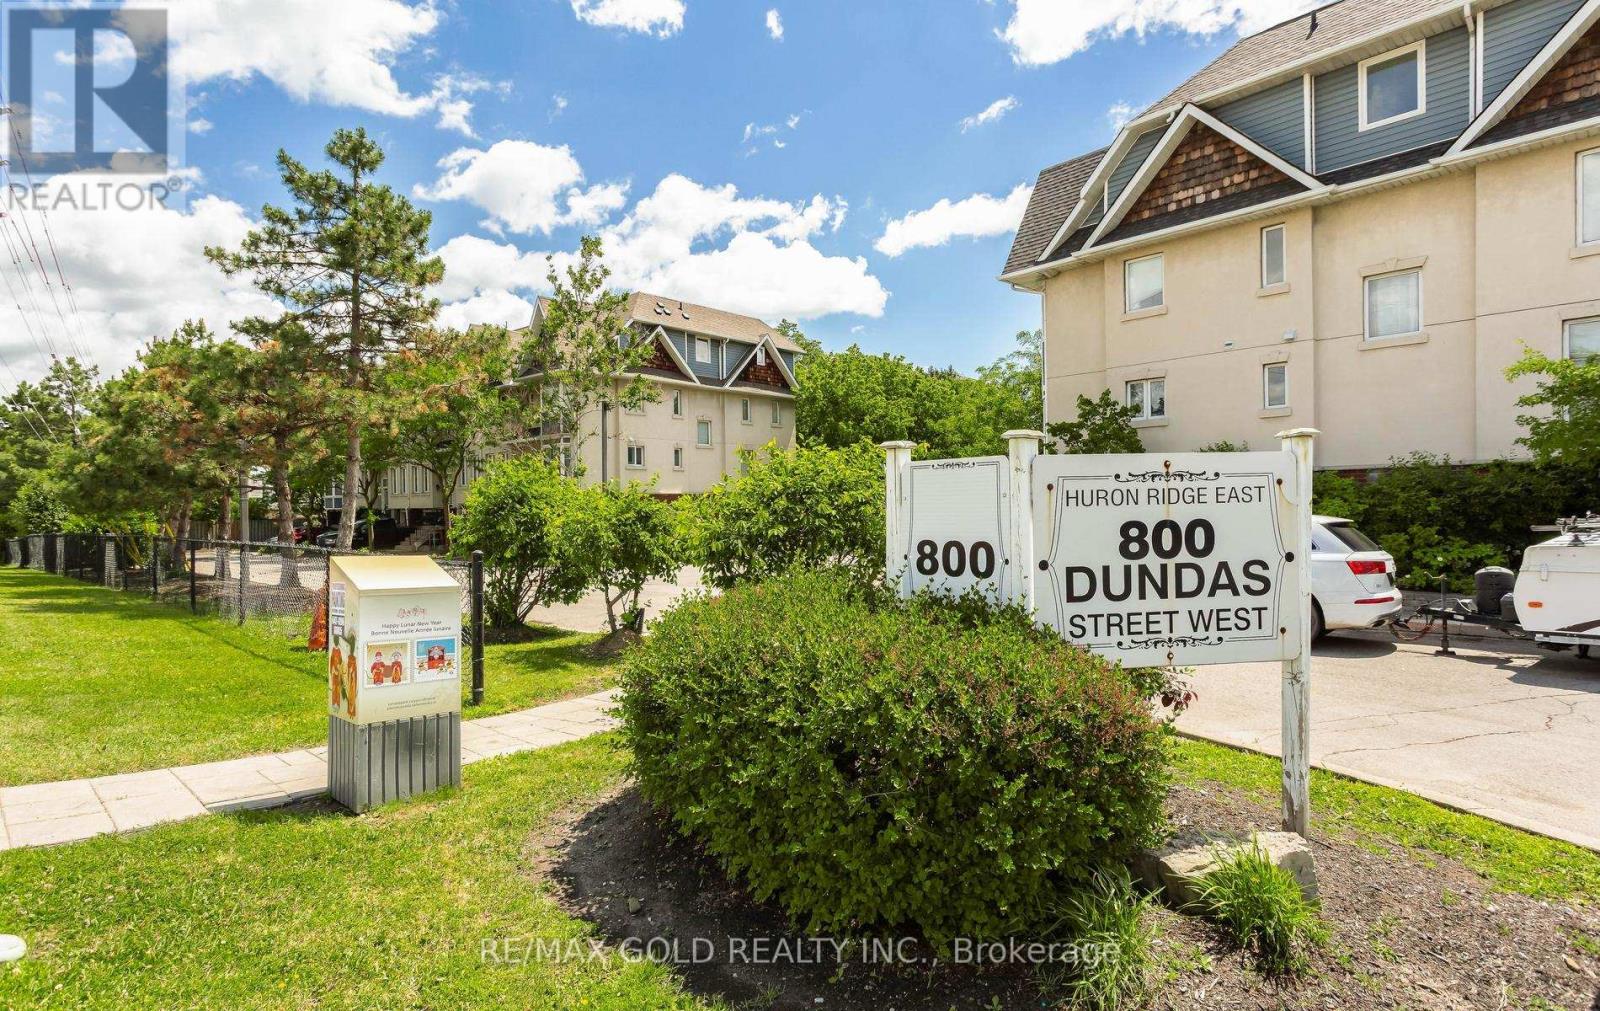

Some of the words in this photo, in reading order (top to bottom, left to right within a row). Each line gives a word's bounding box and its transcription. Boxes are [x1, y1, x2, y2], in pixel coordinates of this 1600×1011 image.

[1065, 487, 1140, 507] HURON
[1147, 485, 1208, 505] RIDGE
[1215, 484, 1266, 504] EAST
[915, 539, 996, 579] 800
[1118, 518, 1215, 561] 800
[1065, 559, 1272, 603] DUNDAS
[1068, 609, 1179, 639] STREET
[1187, 606, 1269, 634] WEST
